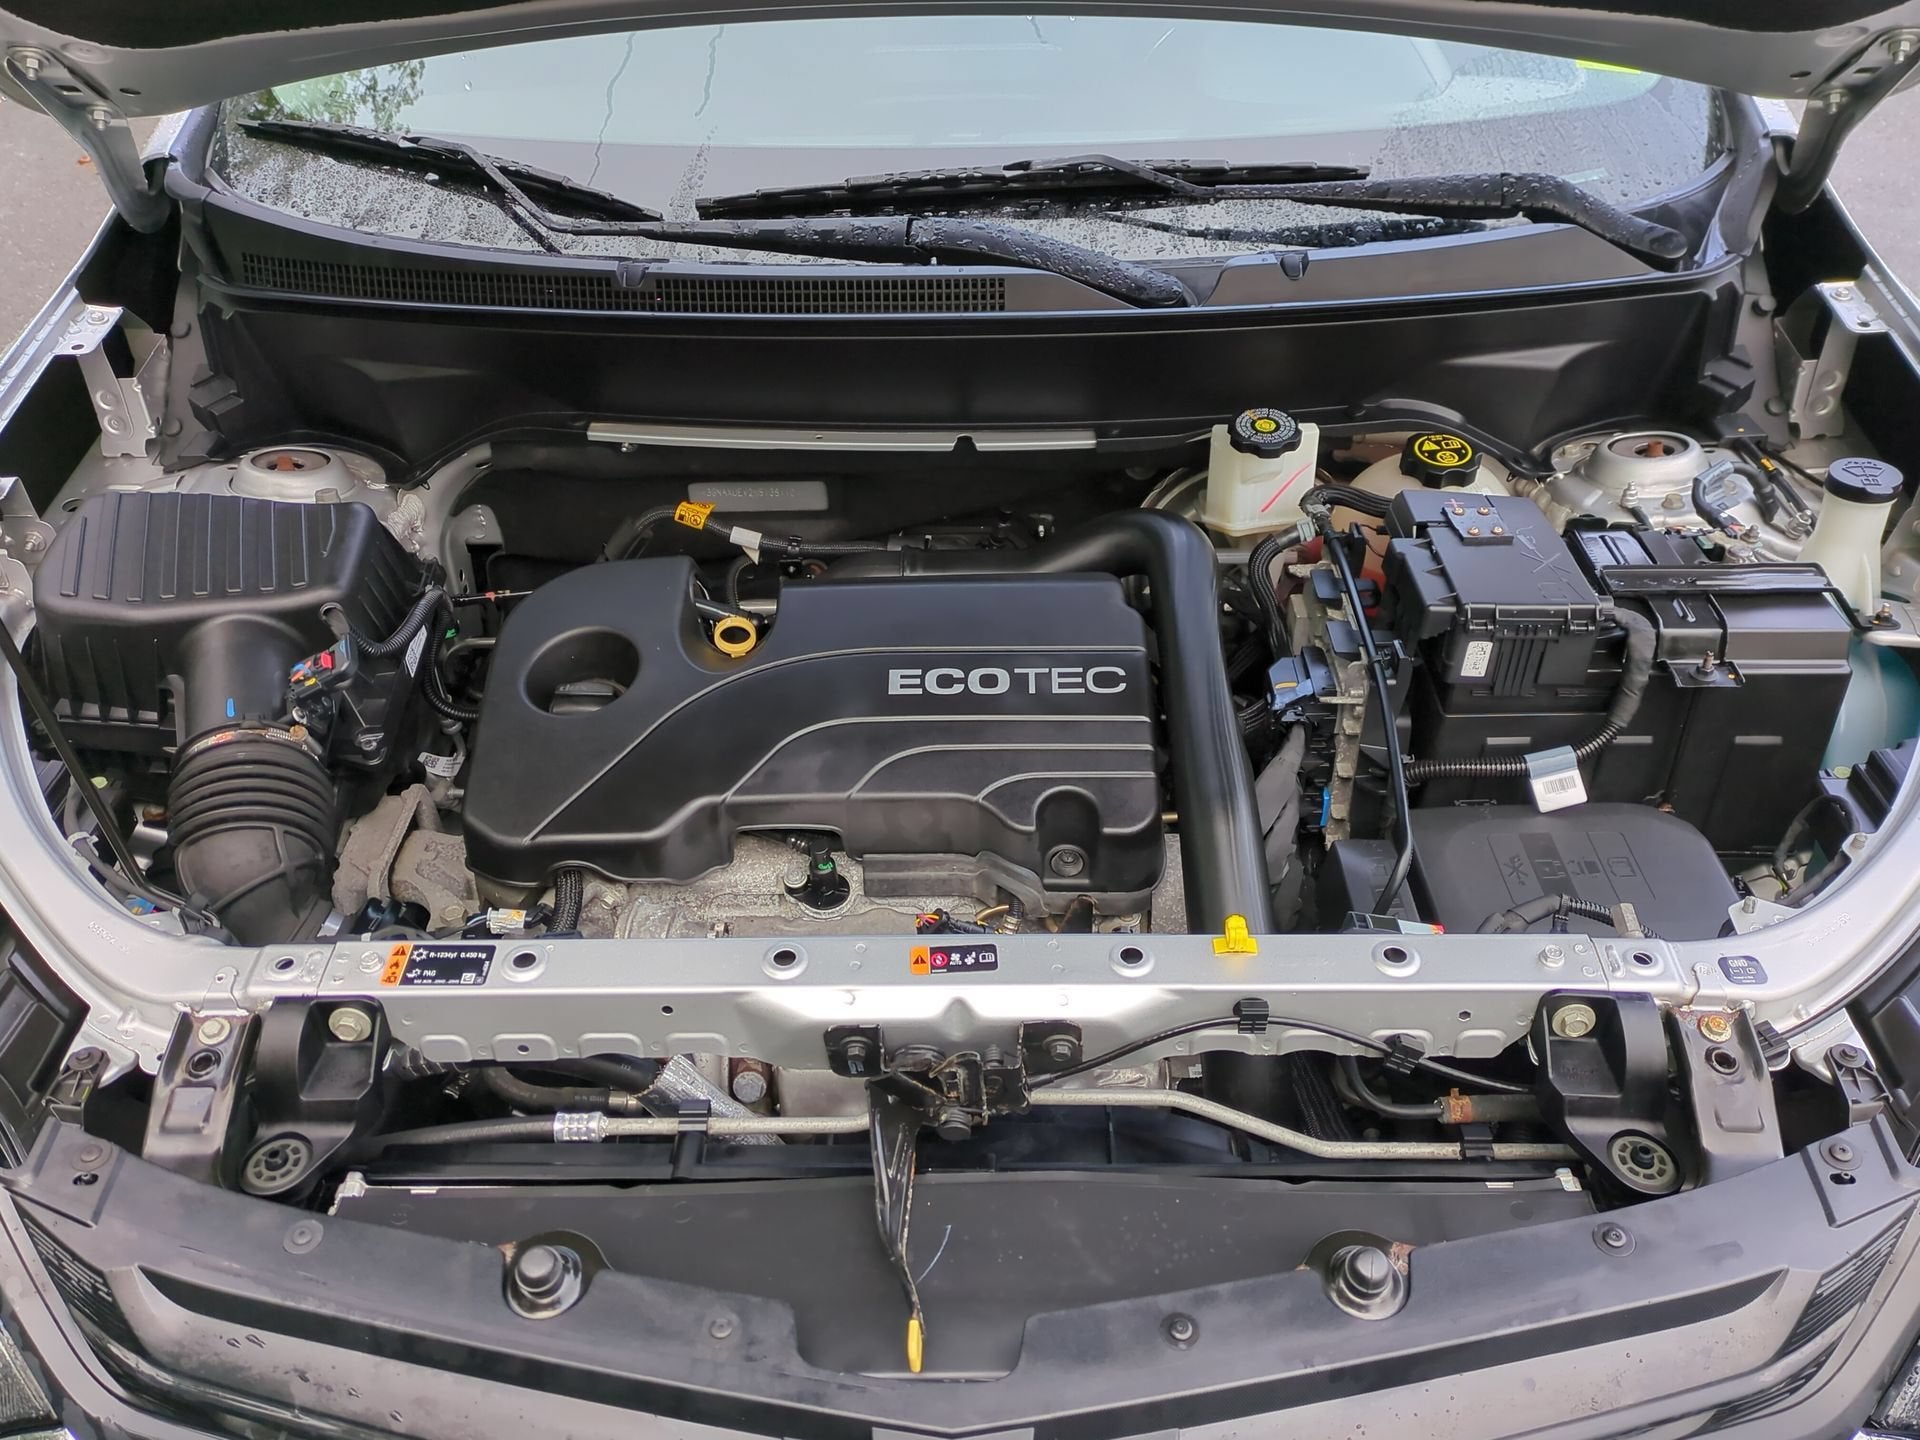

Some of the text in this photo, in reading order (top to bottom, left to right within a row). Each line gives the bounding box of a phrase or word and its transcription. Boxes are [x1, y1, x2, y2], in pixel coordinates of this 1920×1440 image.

[888, 666, 1127, 695] ECOTEC
[429, 951, 457, 959] R-1234yf
[1728, 959, 1748, 967] GND
